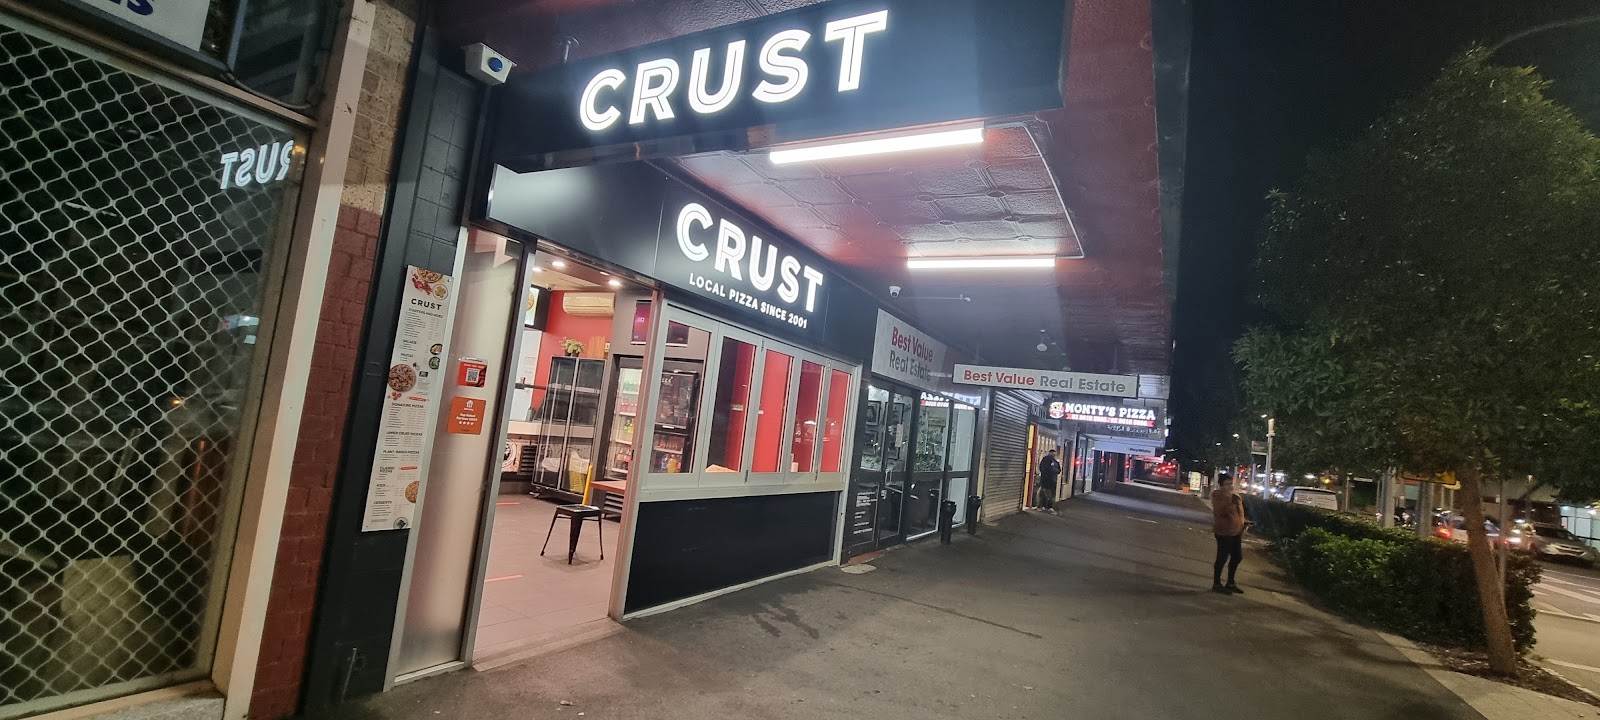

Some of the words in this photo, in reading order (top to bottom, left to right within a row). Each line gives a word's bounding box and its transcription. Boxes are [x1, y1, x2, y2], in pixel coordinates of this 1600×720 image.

[579, 9, 888, 131] CRUST
[676, 202, 824, 313] CRUST
[411, 298, 442, 311] CRUST
[688, 272, 726, 298] LOCAL
[729, 288, 758, 311] PIZZA
[760, 301, 787, 321] SINCE
[788, 312, 808, 329] 2001
[891, 326, 912, 353] Best
[912, 335, 934, 363] Value
[889, 349, 909, 374] Real
[909, 358, 931, 381] Estate
[963, 369, 992, 383] Best
[995, 372, 1035, 386] Value
[1039, 375, 1073, 389] Real
[1078, 378, 1126, 393] Estate
[1064, 402, 1117, 417] MONTY'S
[1118, 406, 1156, 420] PIZZA
